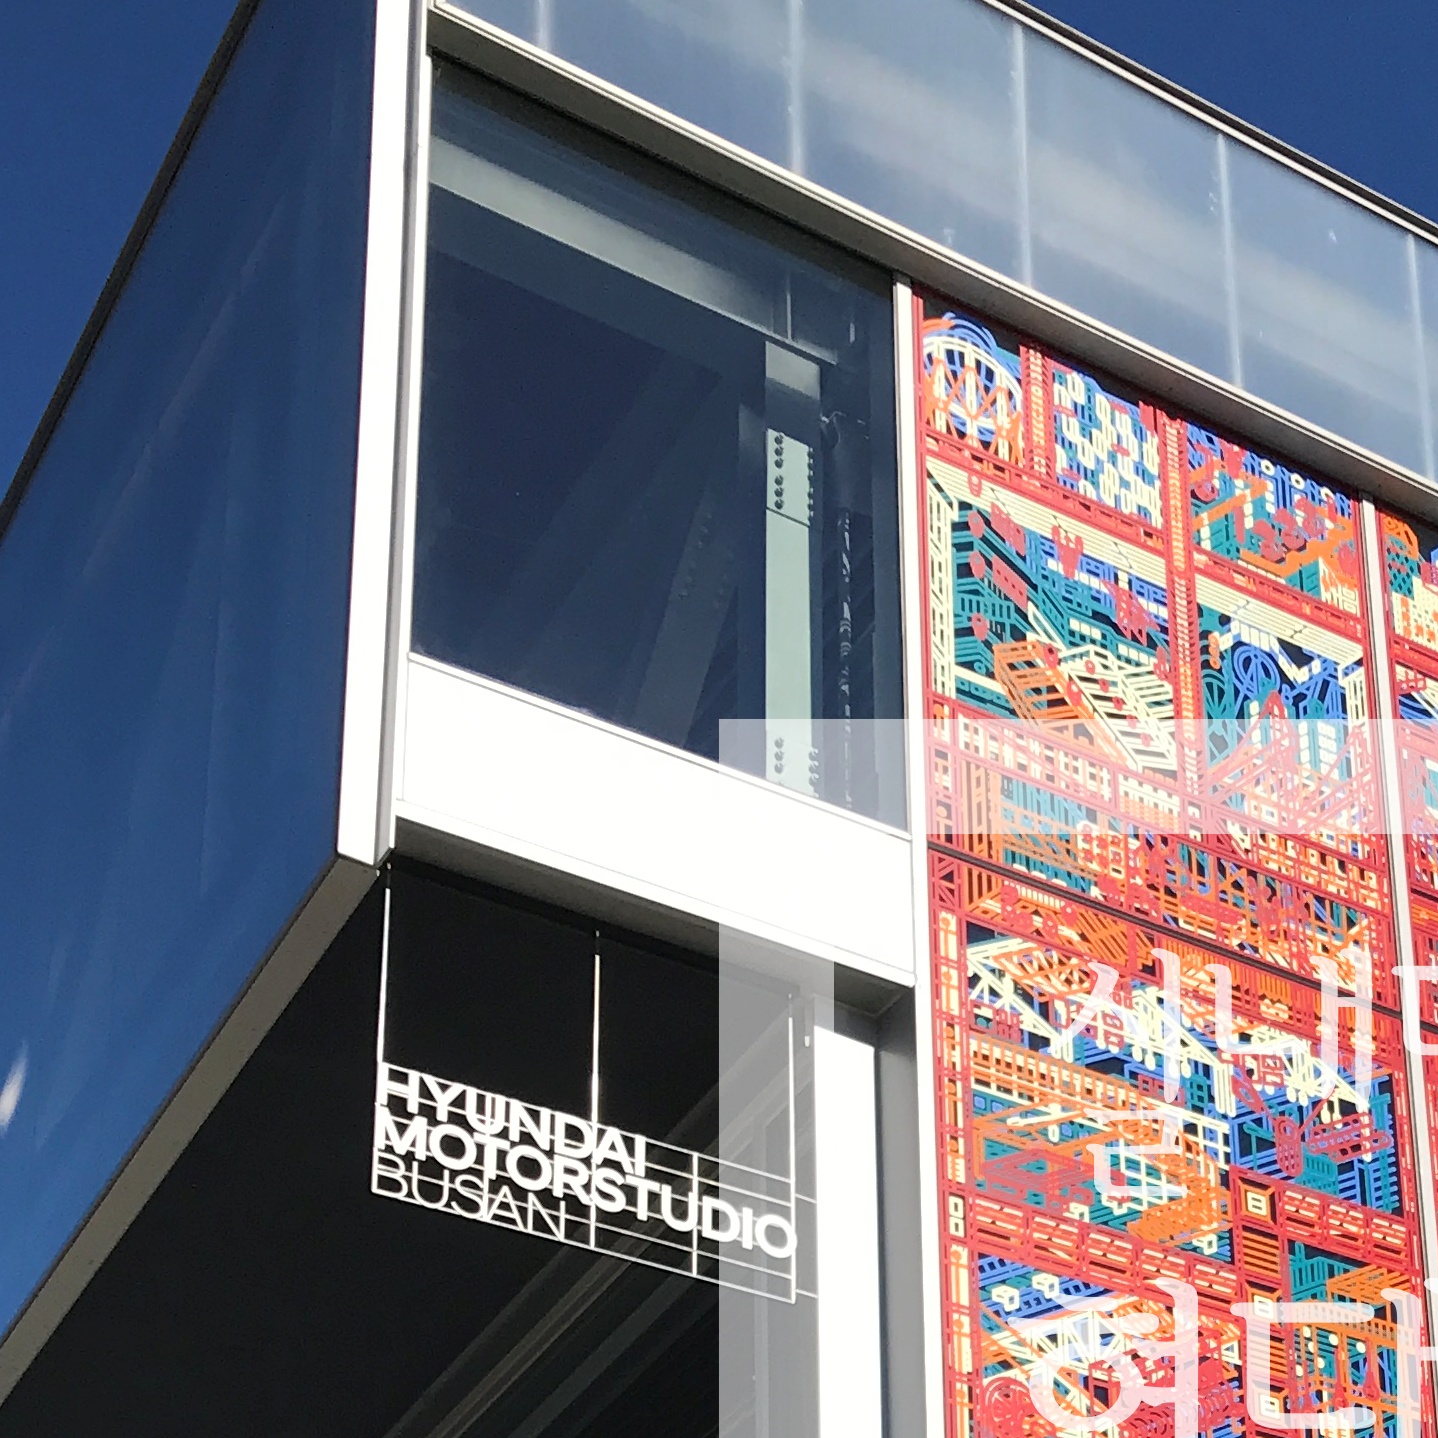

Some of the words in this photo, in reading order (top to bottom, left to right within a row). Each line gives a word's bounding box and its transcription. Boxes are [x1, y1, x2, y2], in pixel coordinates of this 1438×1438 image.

[377, 1062, 646, 1176] HYUNDAI
[372, 1152, 567, 1242] BUSAN
[375, 1102, 798, 1259] MOTORSTUDIO
